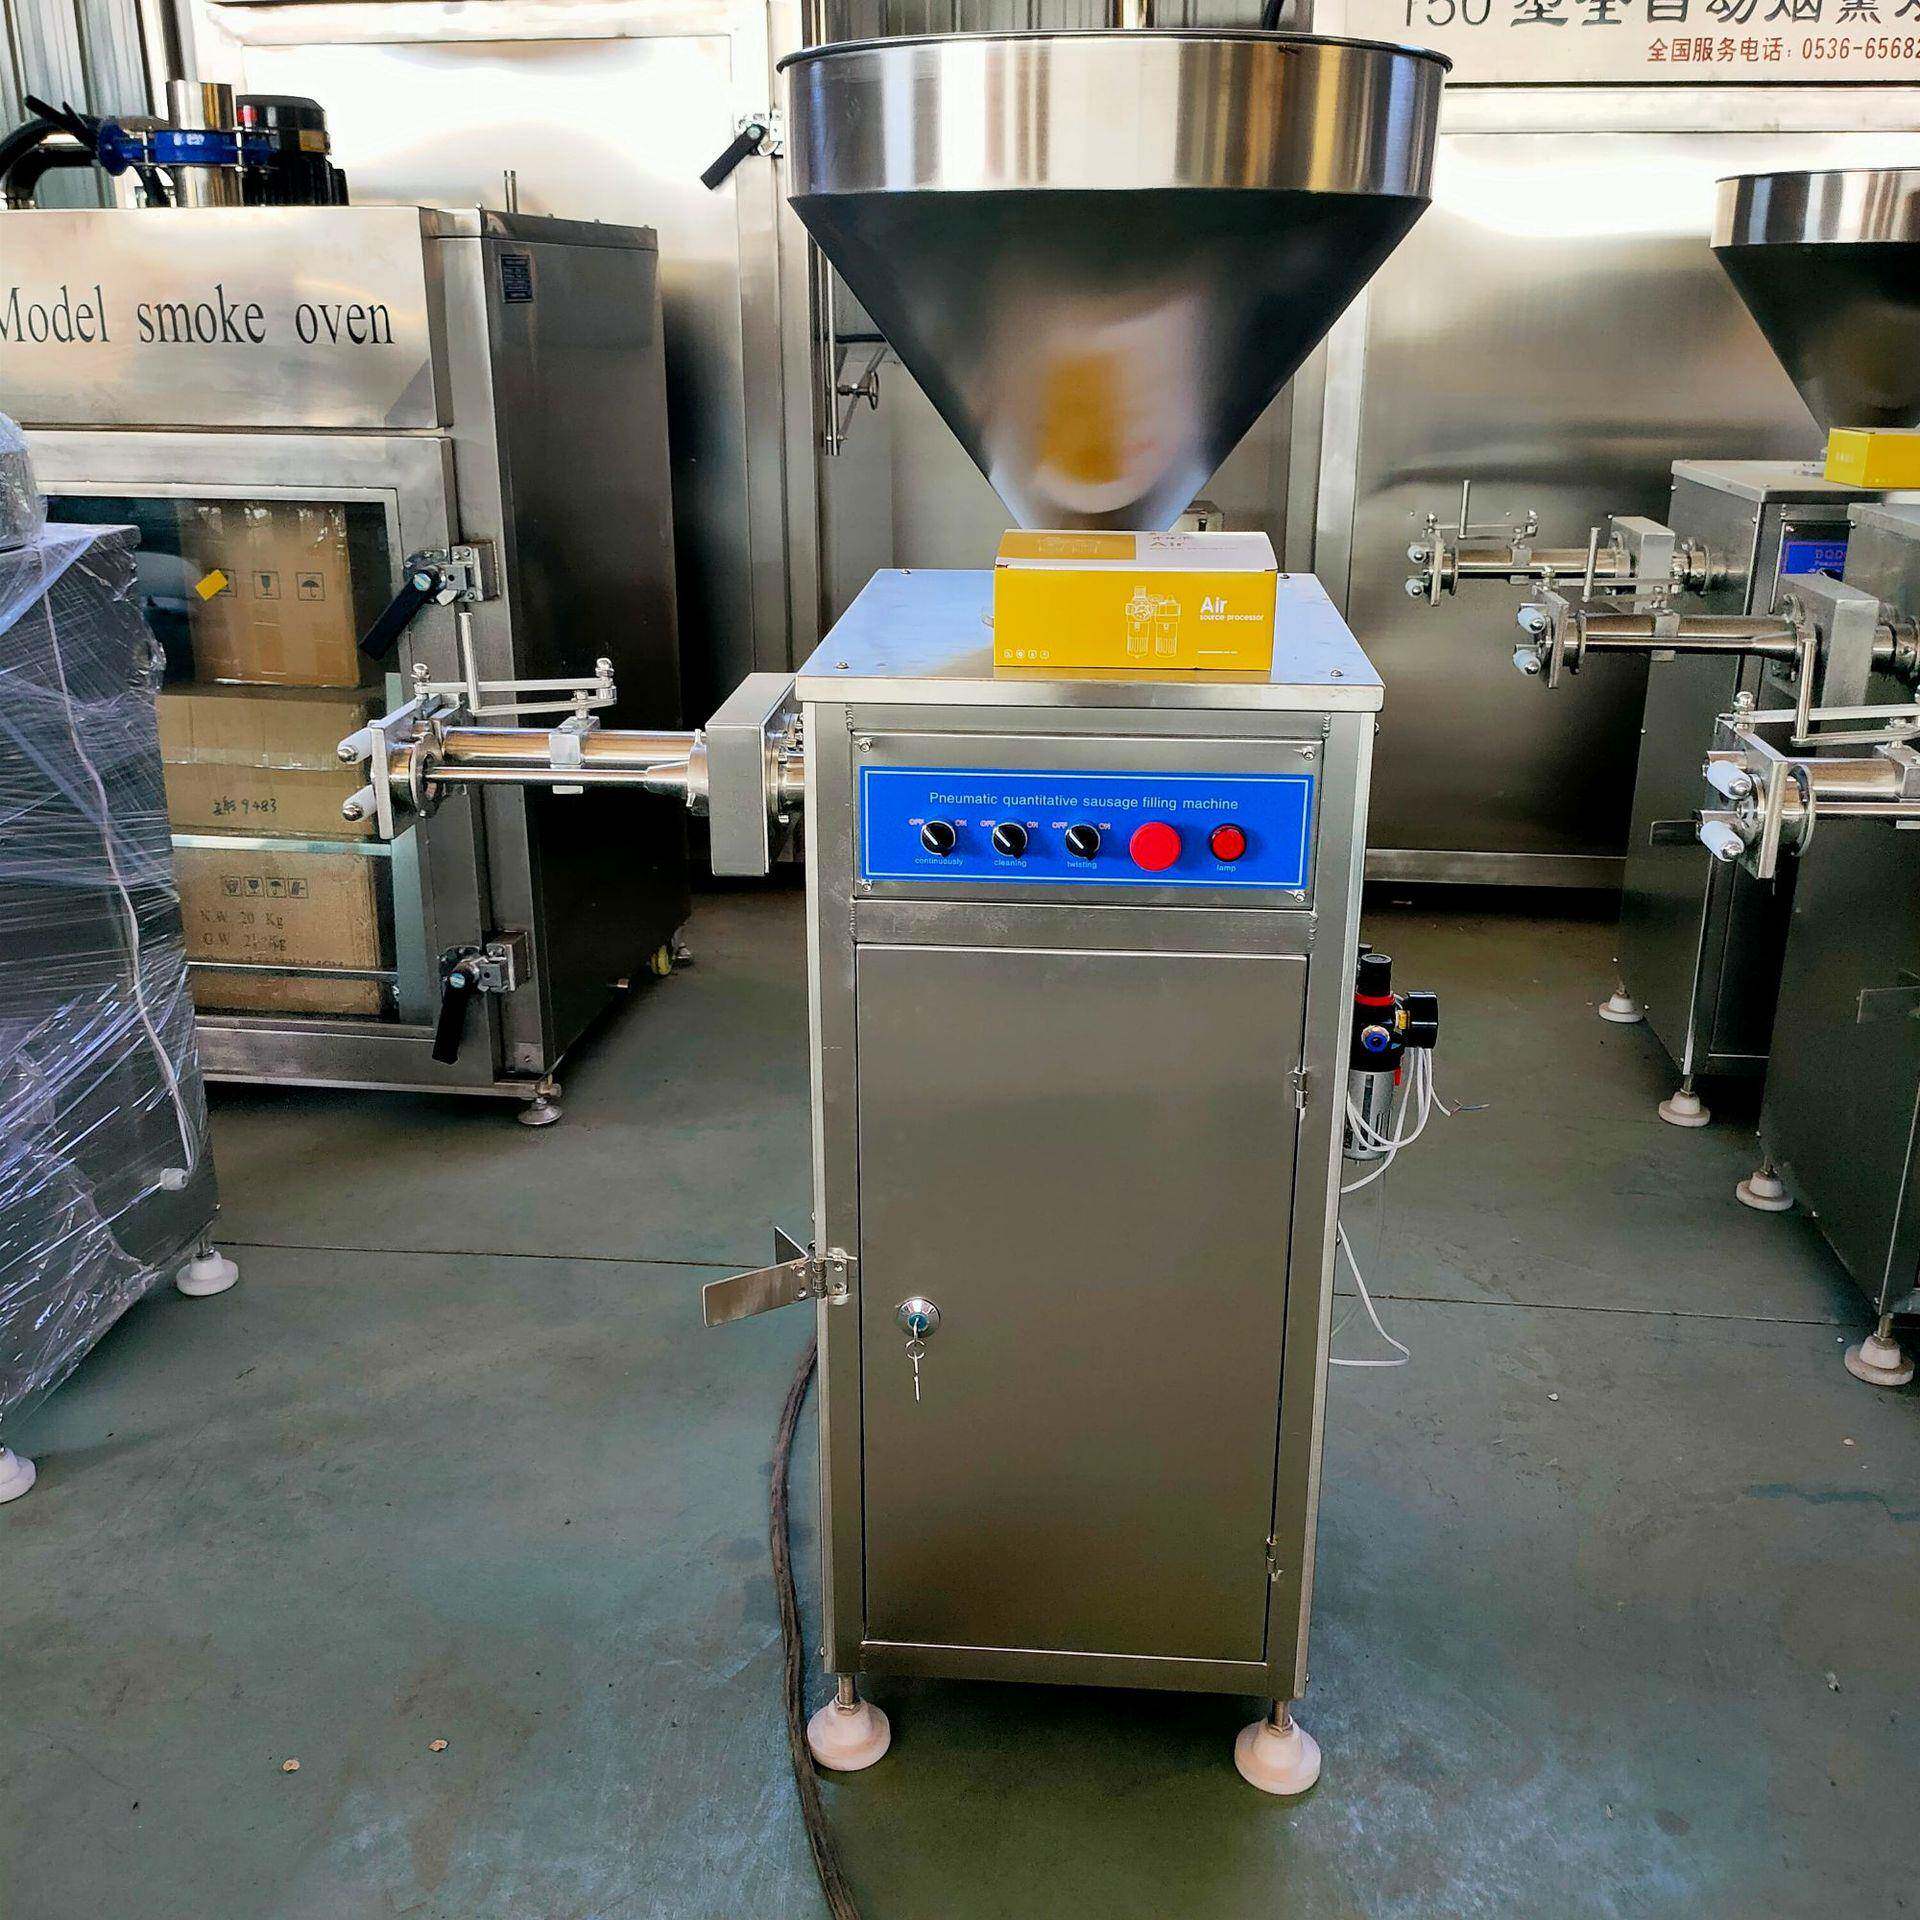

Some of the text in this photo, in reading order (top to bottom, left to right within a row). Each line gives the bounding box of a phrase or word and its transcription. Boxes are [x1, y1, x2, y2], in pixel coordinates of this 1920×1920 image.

[0, 284, 395, 344] Model smoke oven
[1199, 595, 1228, 614] Air
[929, 791, 1239, 811] Pneumatic quantitative sausage filling machine
[914, 857, 1238, 873] continuously cleaning twisting lamp
